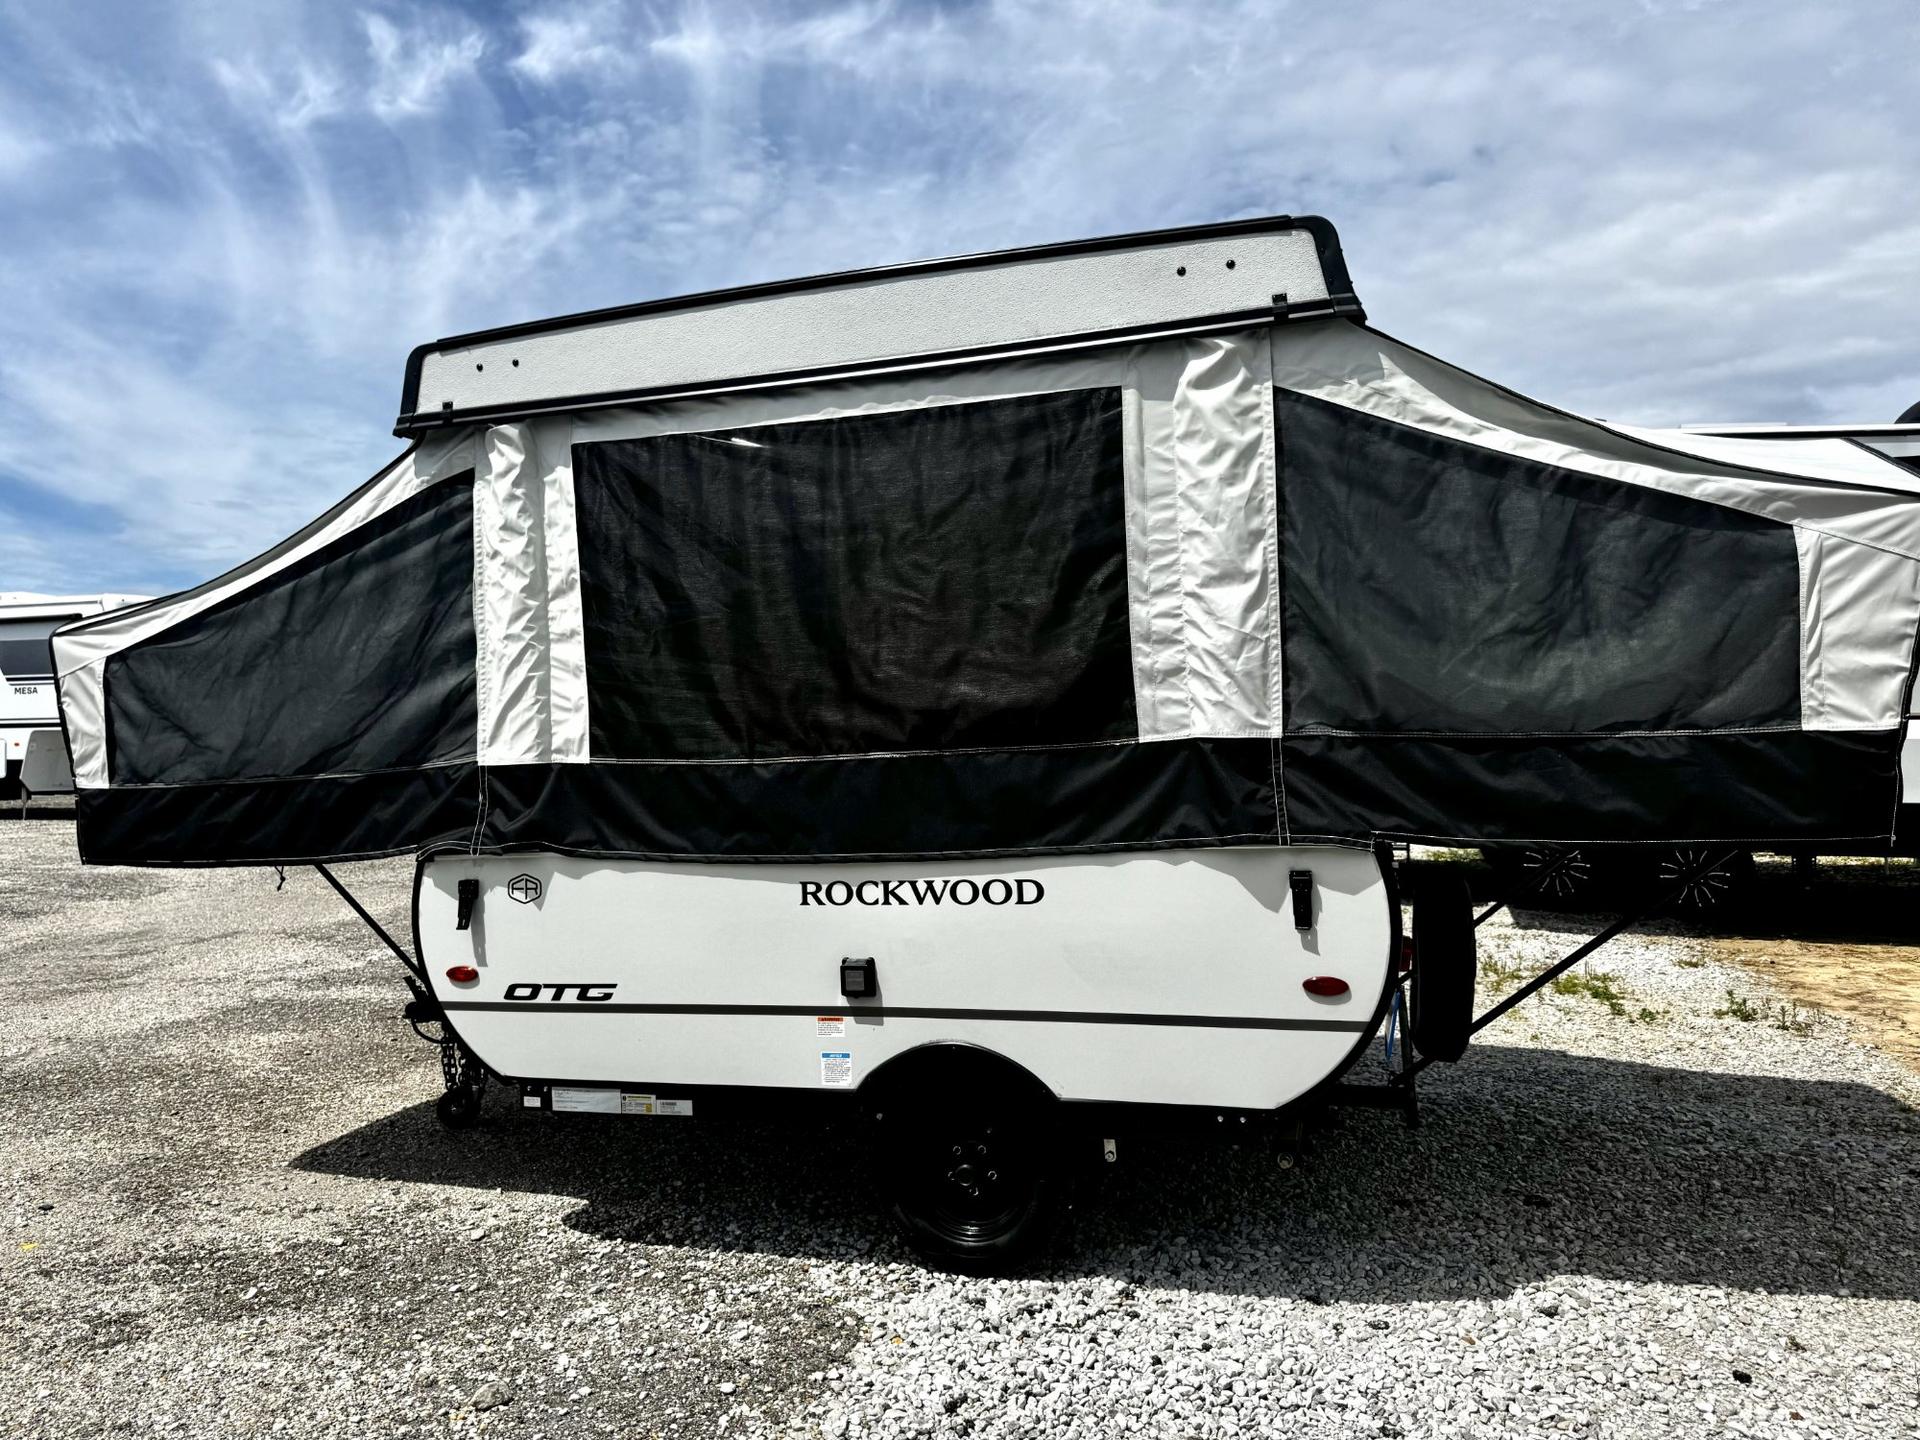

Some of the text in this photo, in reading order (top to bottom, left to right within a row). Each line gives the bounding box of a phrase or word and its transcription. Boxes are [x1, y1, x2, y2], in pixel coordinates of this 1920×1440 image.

[14, 687, 38, 695] MESA
[799, 879, 1045, 906] ROCKWOOD
[503, 983, 618, 1002] OTG
